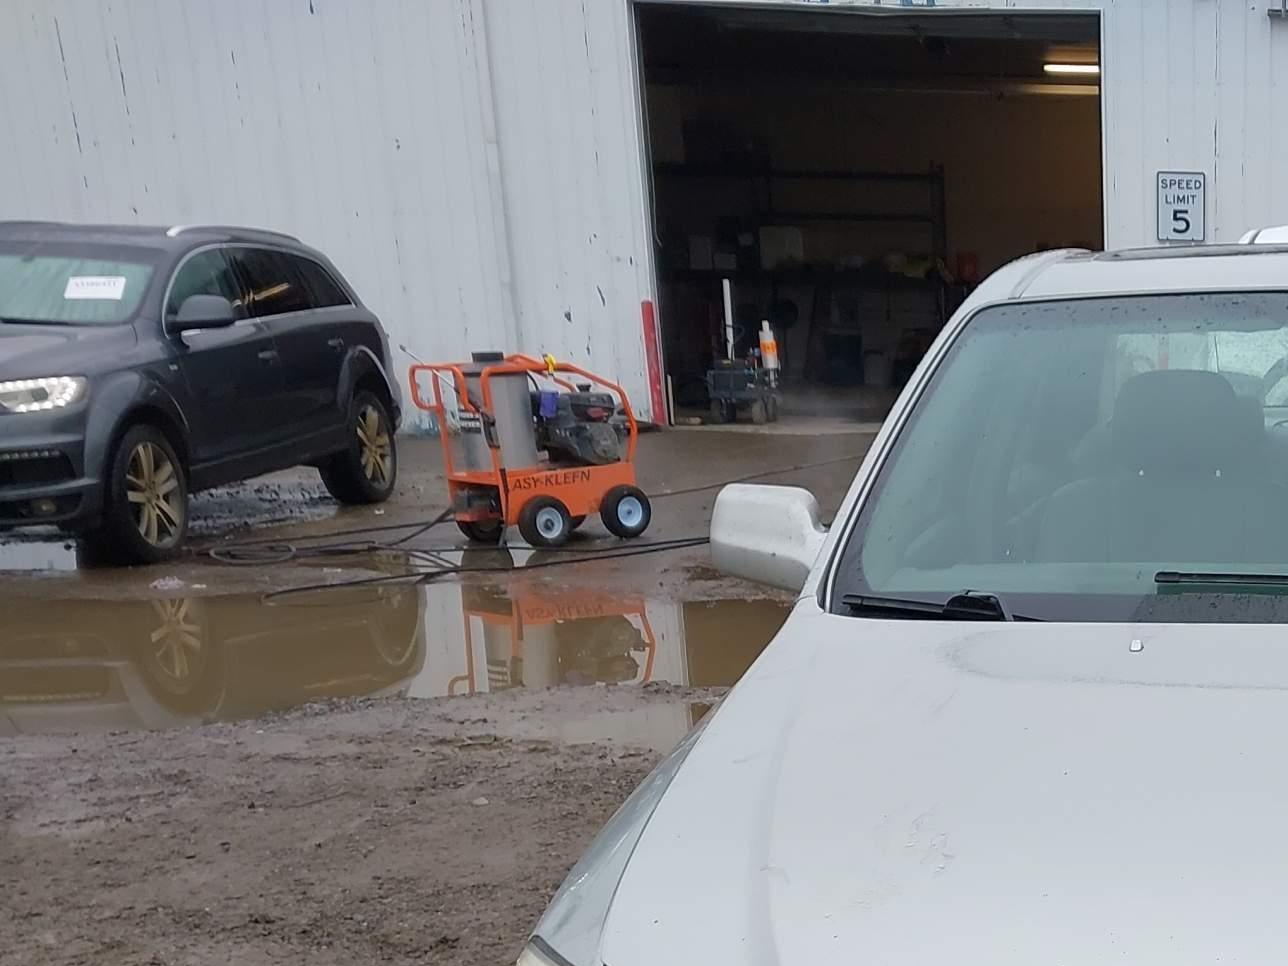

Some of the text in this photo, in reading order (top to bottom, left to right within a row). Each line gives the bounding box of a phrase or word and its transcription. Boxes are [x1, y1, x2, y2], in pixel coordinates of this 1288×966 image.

[1161, 179, 1202, 190] SPEED
[1165, 194, 1197, 205] LIMIT
[1172, 209, 1190, 234] 5
